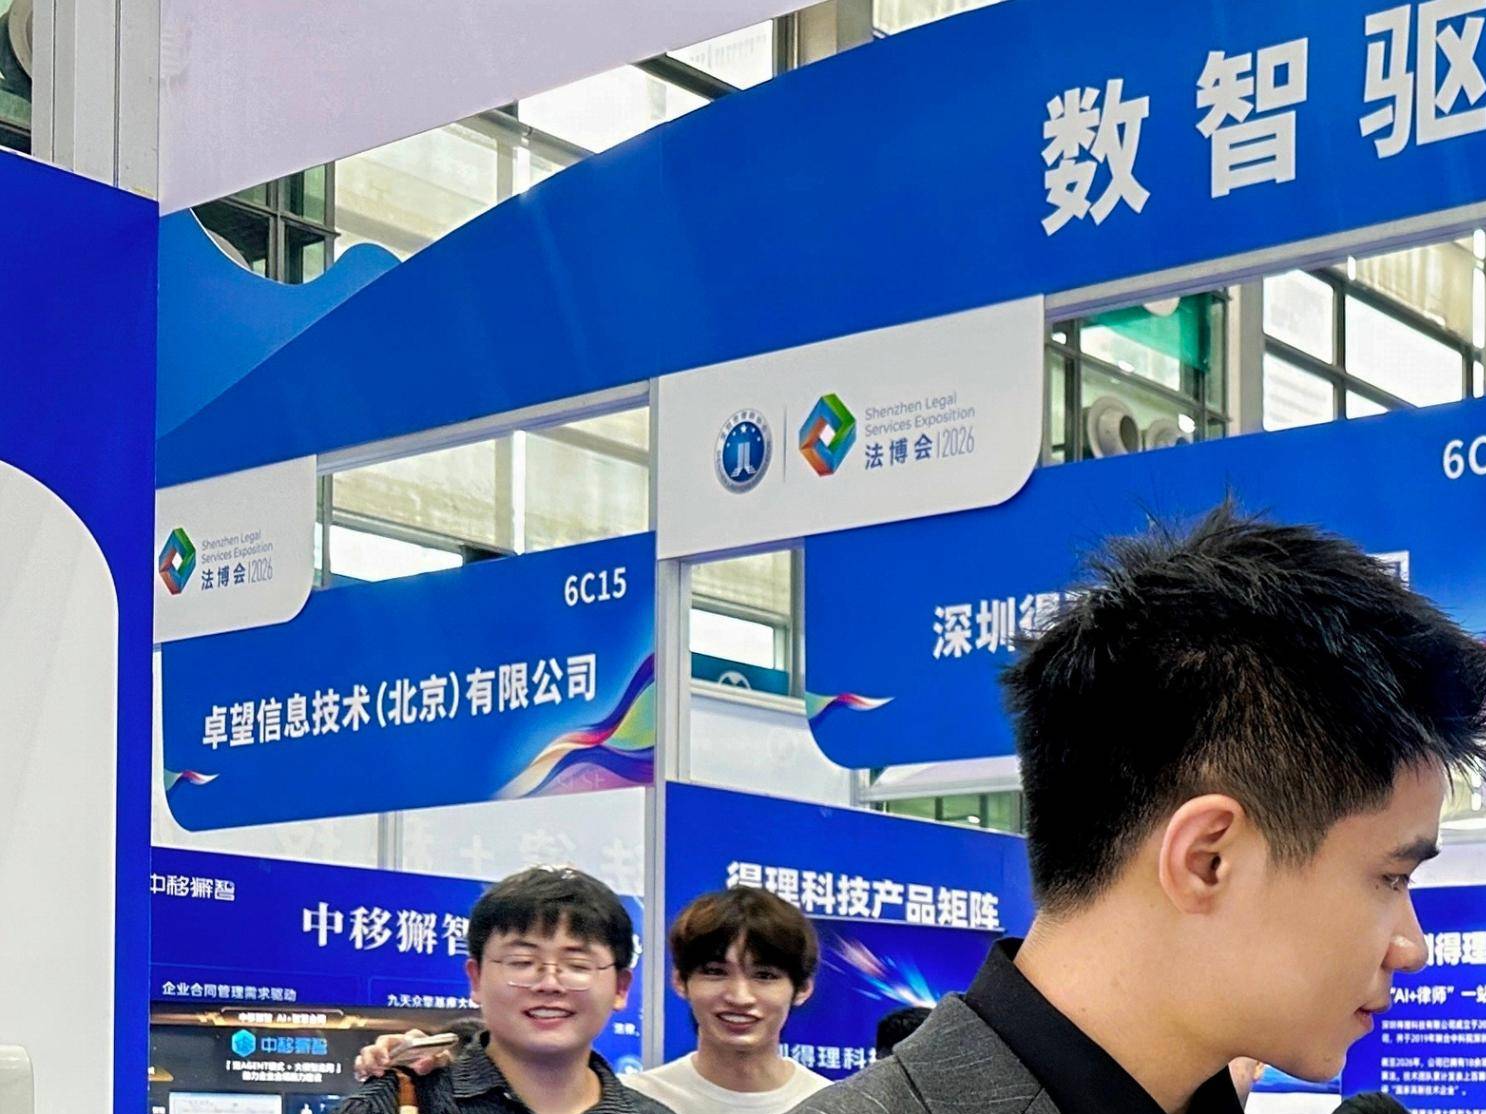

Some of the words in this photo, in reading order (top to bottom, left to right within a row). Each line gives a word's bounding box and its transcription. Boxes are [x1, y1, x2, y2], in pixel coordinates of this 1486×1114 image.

[865, 400, 922, 421] Shenzhen
[925, 391, 958, 413] Legal
[865, 418, 912, 438] Services
[915, 405, 975, 430] Exposition
[864, 433, 933, 471] 法博会
[940, 426, 975, 458] 2026
[201, 562, 246, 590] 法博会
[250, 557, 273, 583] 2026
[563, 567, 628, 607] 6C15
[932, 589, 1088, 660] 深圳得
[202, 652, 597, 751] 卓望信息技术(北京)有限公司
[725, 860, 1000, 930] 得理科技产品矩阵
